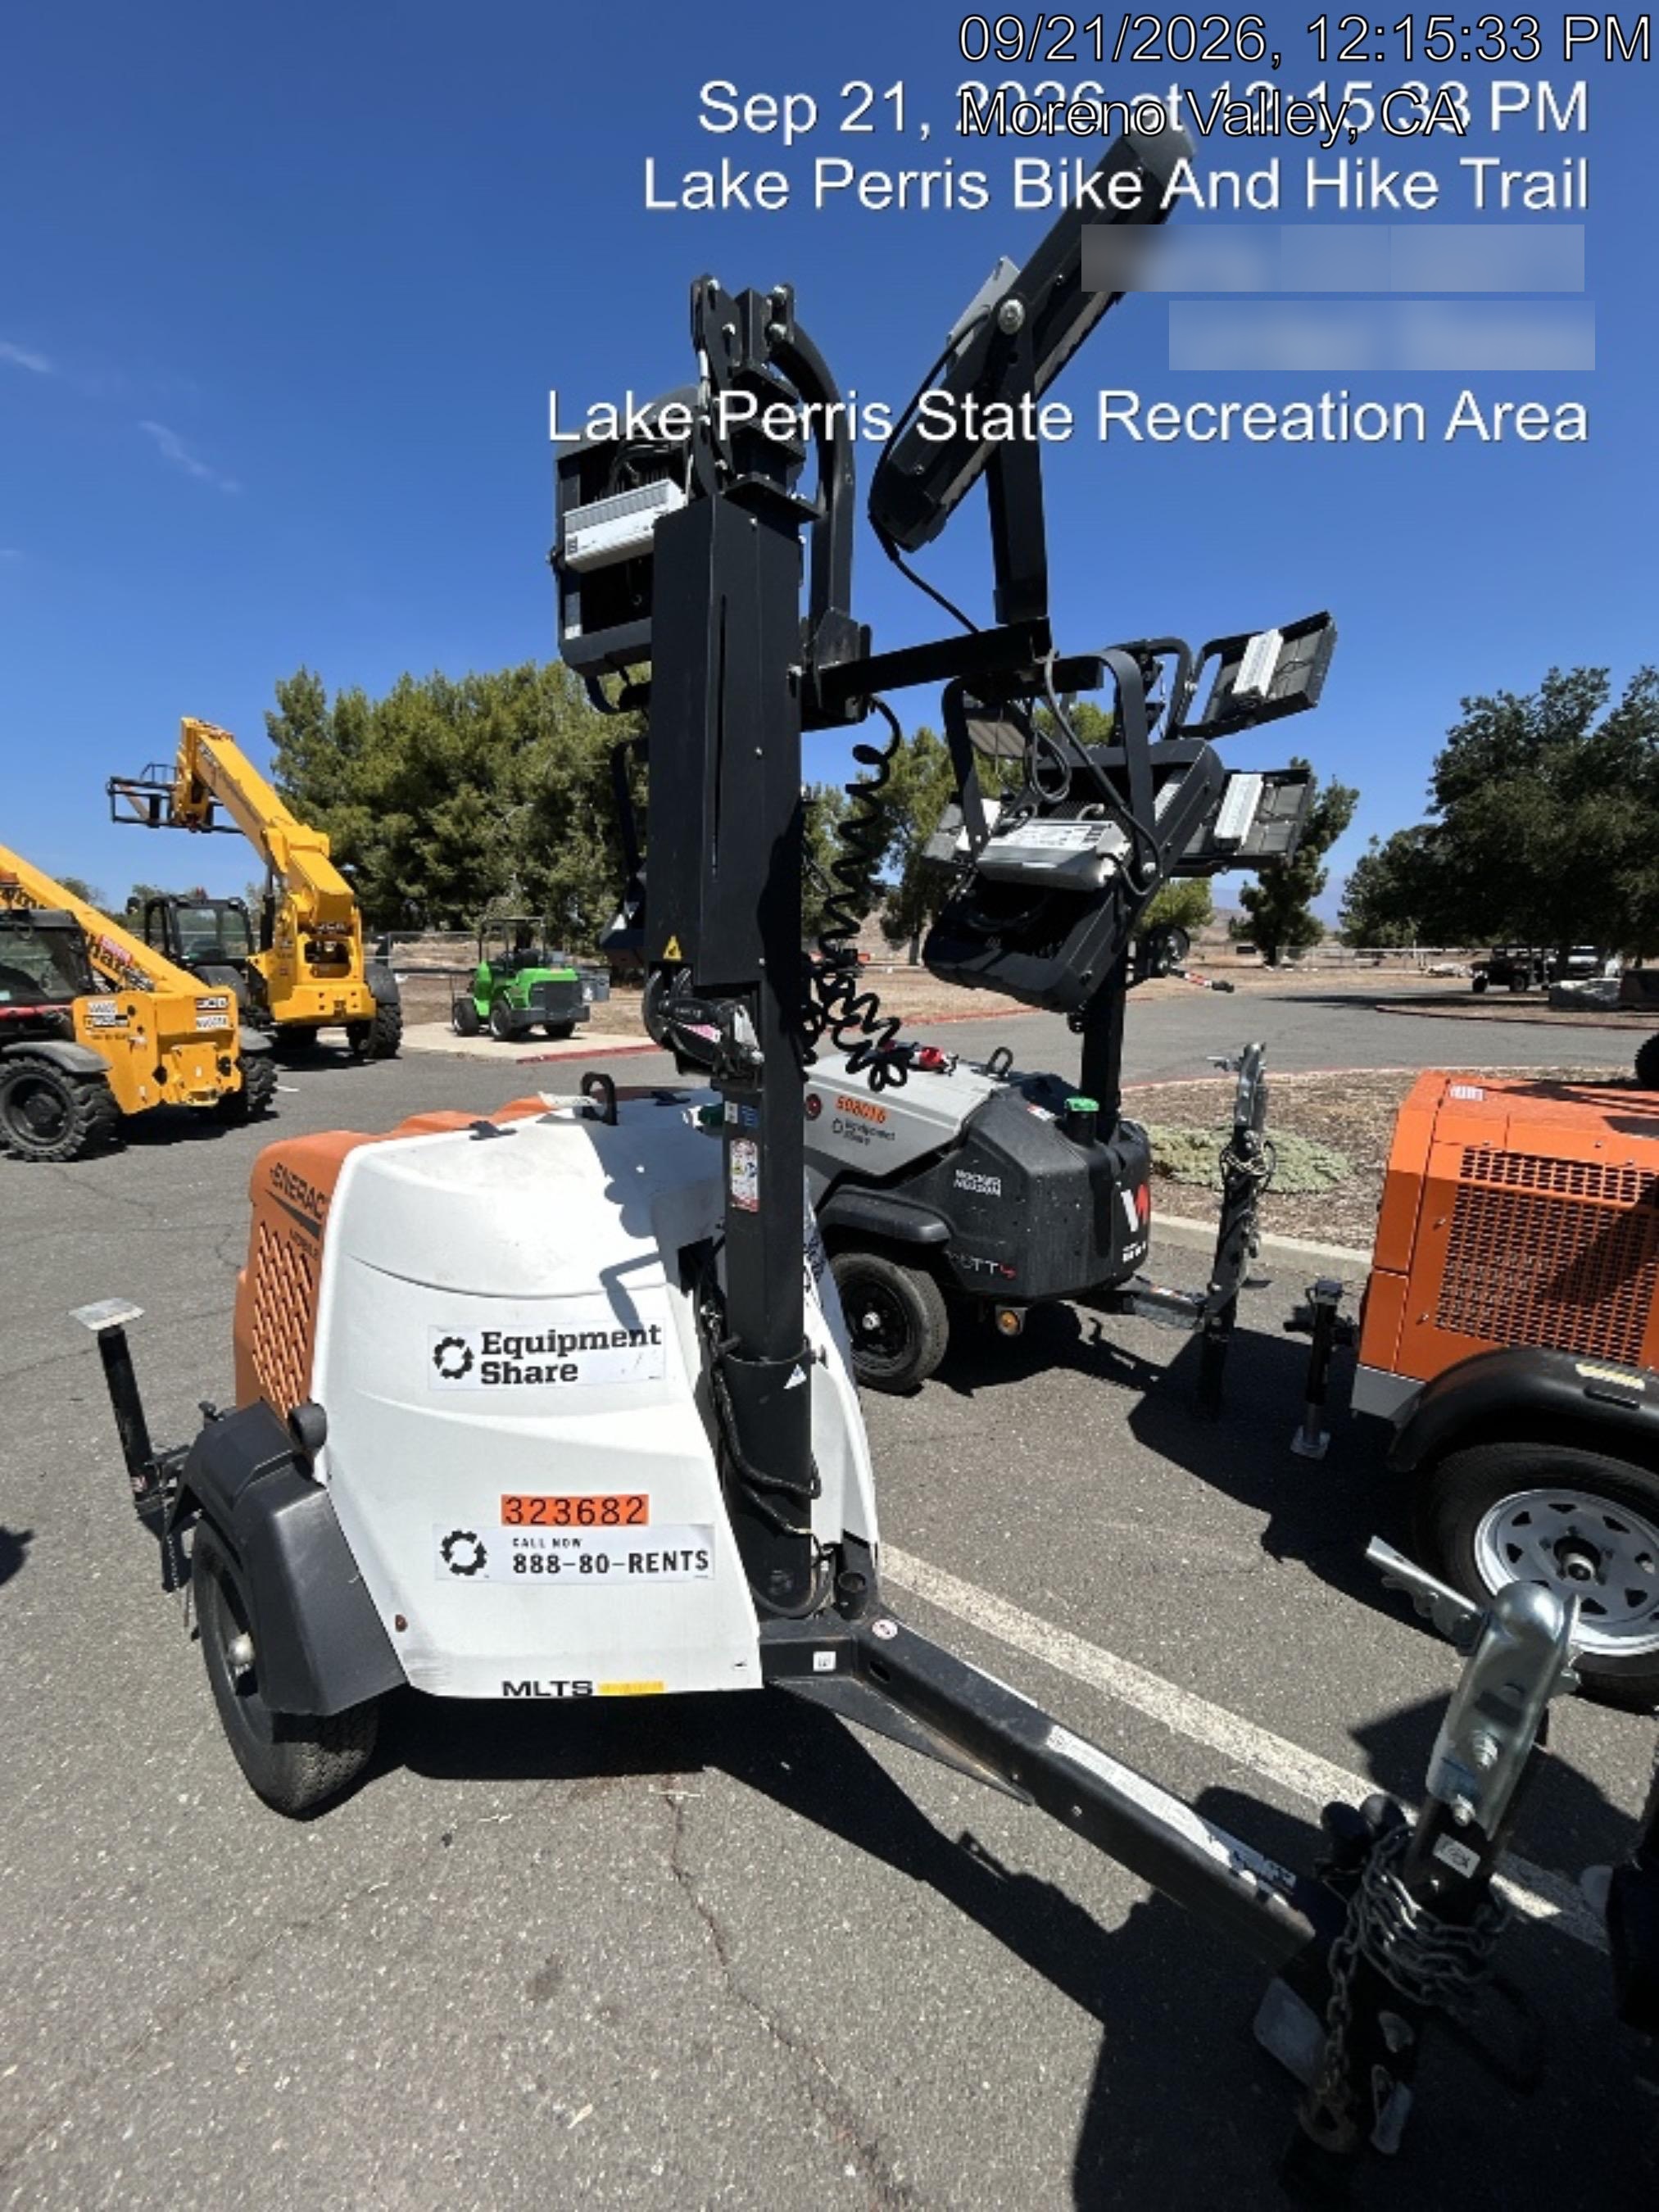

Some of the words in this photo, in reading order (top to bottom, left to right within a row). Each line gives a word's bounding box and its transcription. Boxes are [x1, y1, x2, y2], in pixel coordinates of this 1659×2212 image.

[480, 1324, 662, 1360] Equipment
[480, 1361, 578, 1385] Share
[505, 1496, 645, 1525] 323682
[513, 1538, 546, 1548] CALL
[552, 1538, 583, 1548] NOW
[513, 1550, 709, 1575] 888-80-RENTS
[502, 1680, 593, 1697] MLTS
